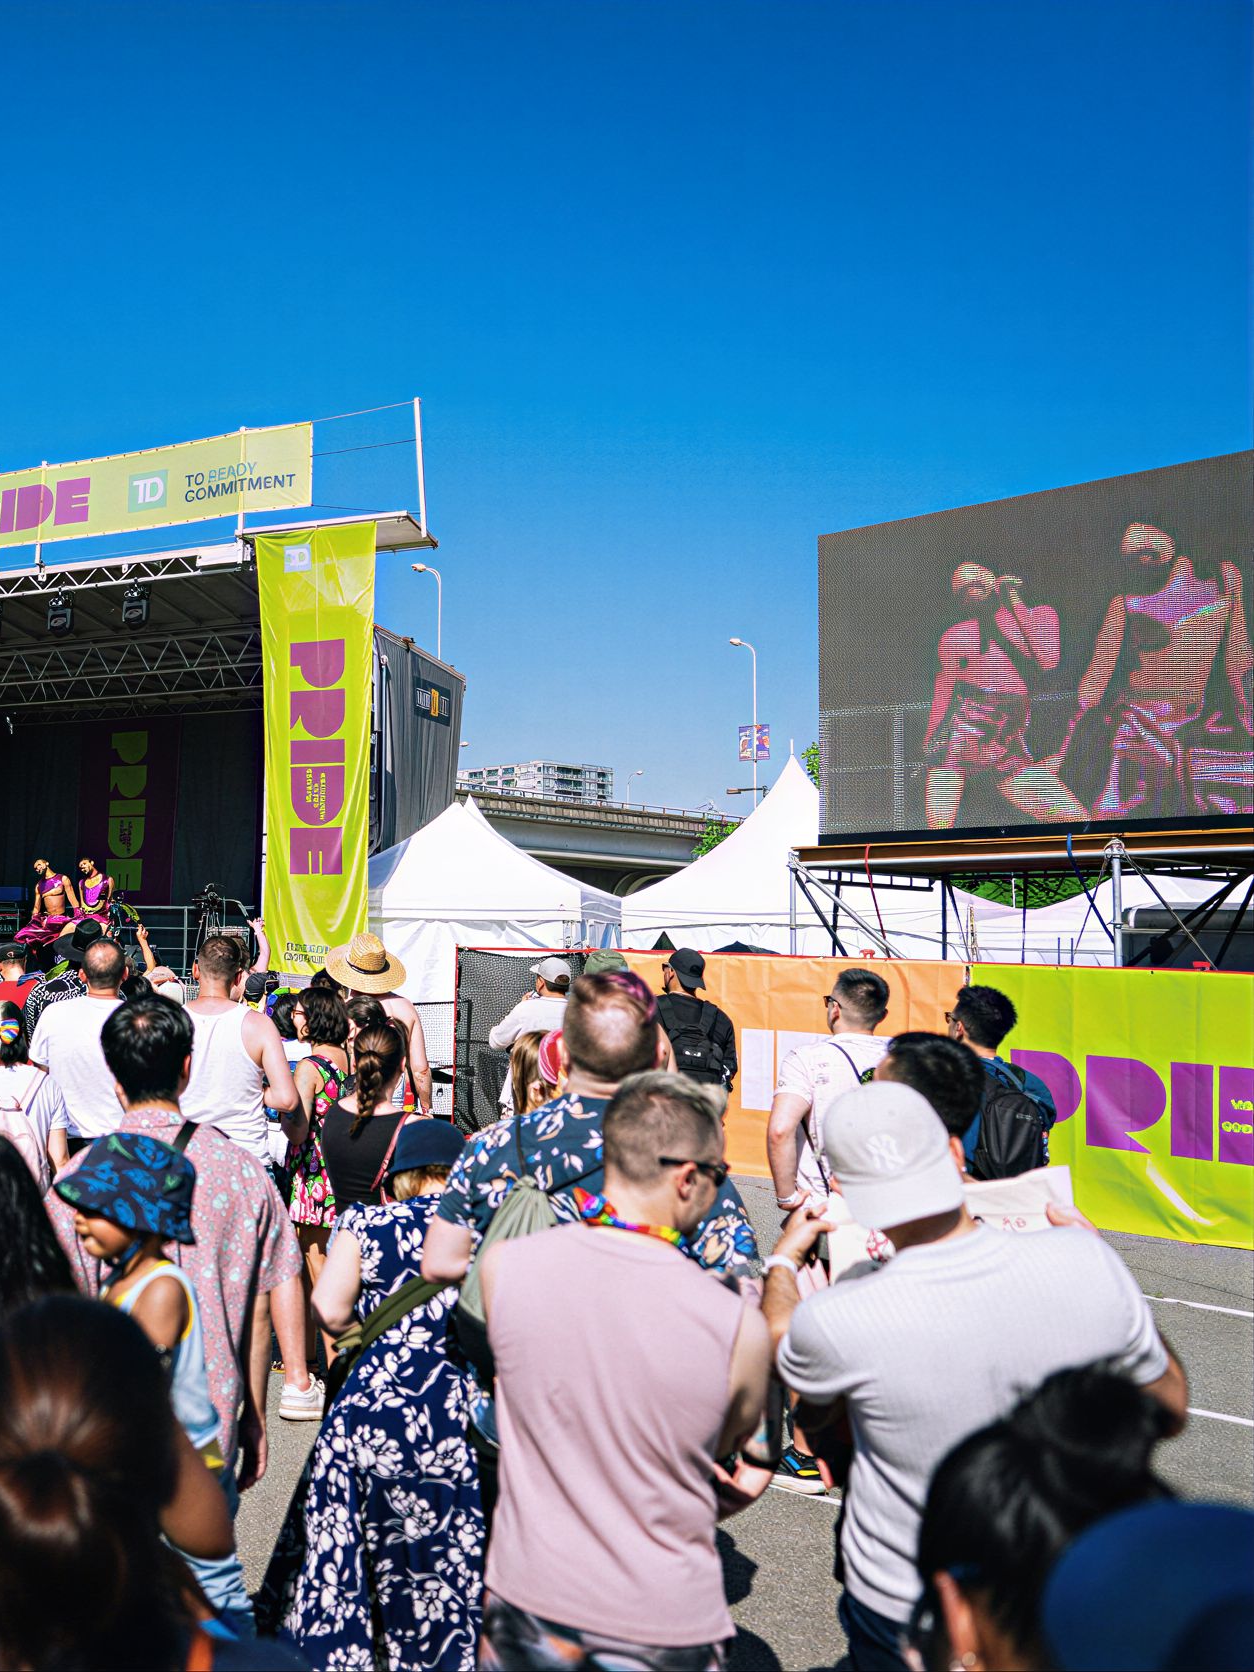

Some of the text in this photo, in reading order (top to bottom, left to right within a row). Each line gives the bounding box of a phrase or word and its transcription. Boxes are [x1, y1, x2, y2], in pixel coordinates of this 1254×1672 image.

[133, 477, 165, 505] TD
[185, 472, 205, 487] TO
[290, 638, 345, 875] PRIDE
[106, 731, 148, 891] PRIDE
